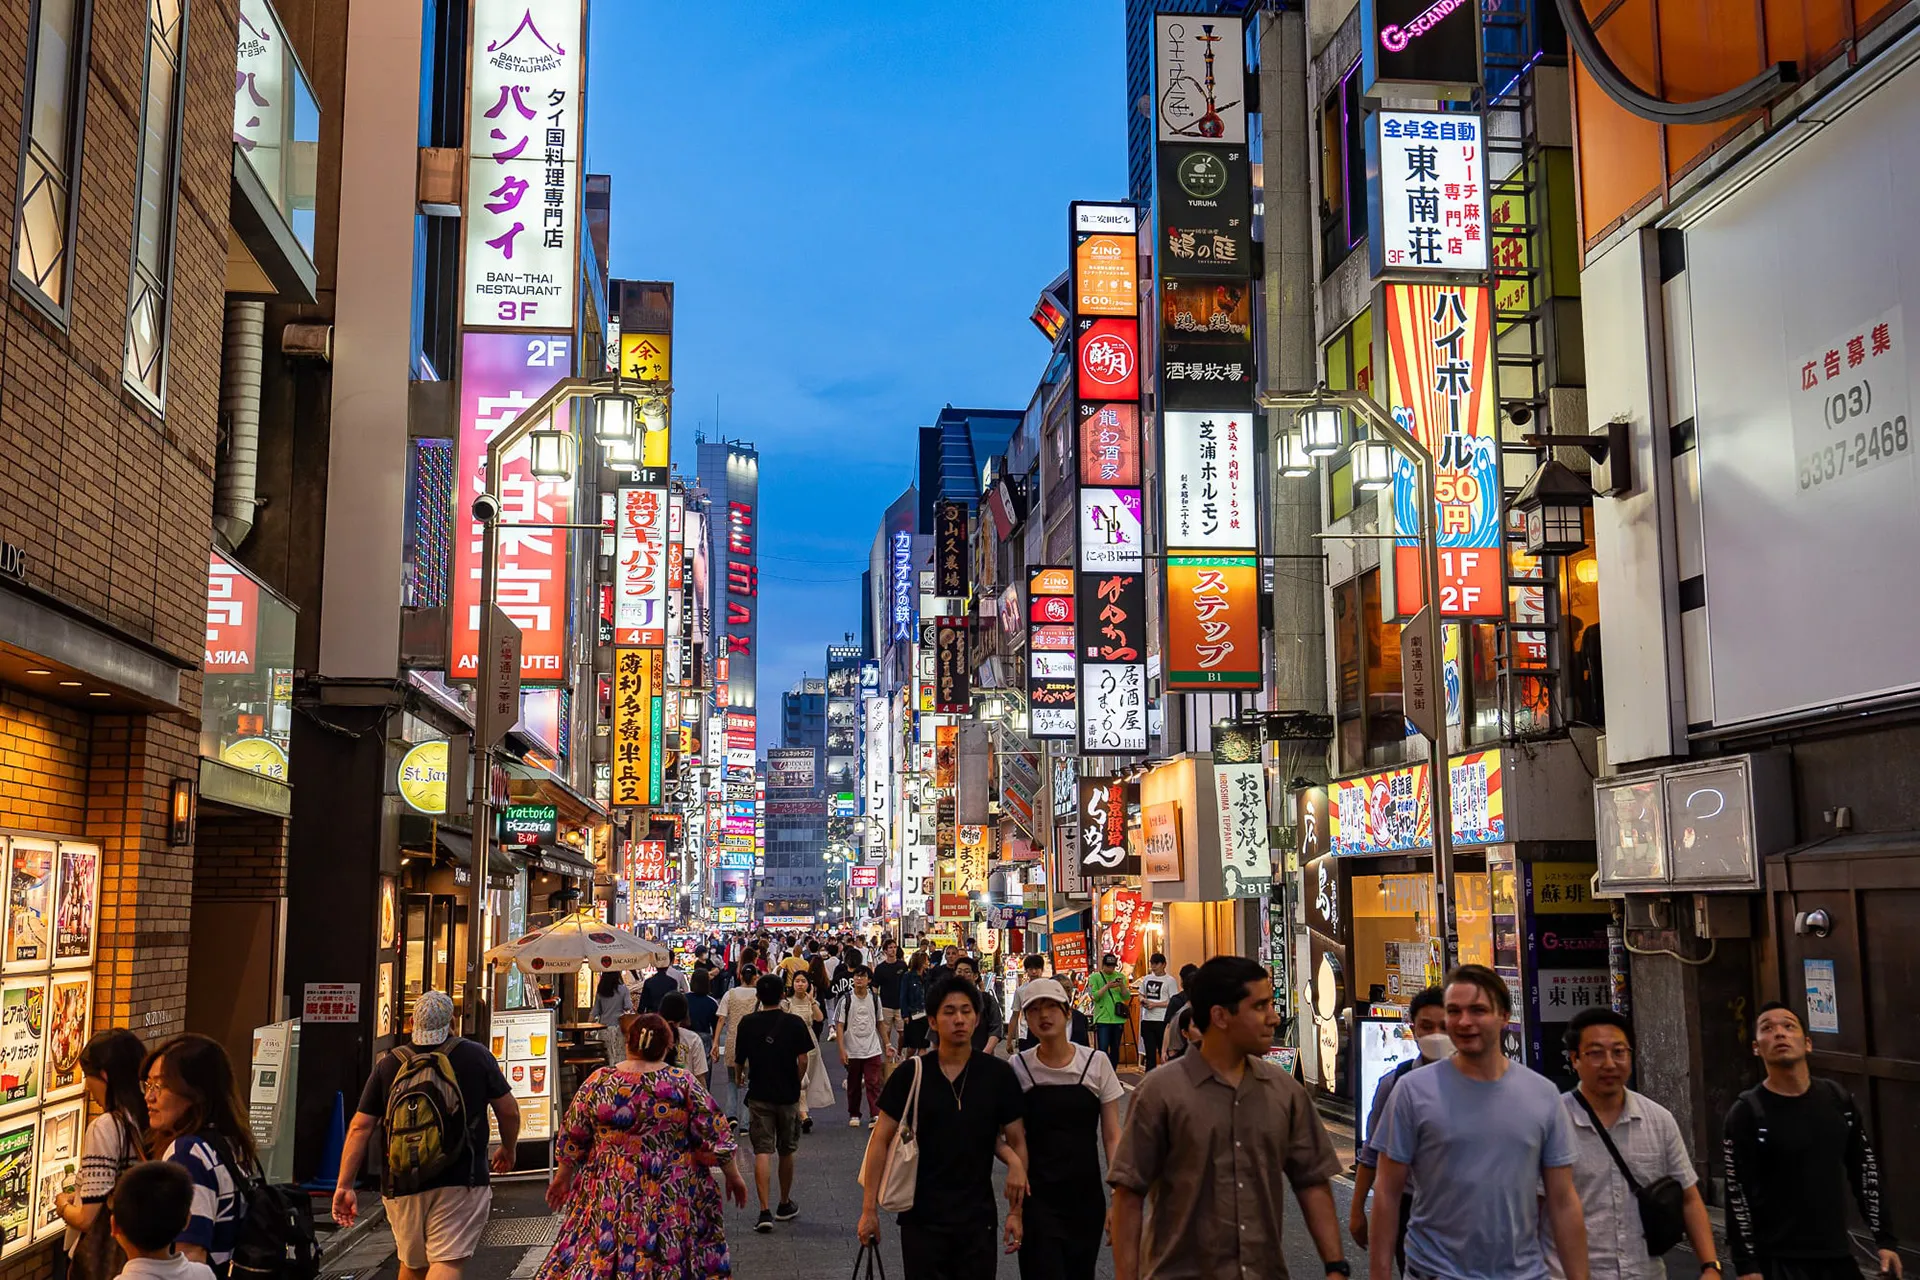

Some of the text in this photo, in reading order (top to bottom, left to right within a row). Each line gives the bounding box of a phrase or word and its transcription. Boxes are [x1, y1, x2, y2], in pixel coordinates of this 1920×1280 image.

[489, 58, 563, 74] RESTAURANT
[498, 52, 553, 65] BAN-THAI
[1384, 119, 1476, 141] 全卓全自動
[1229, 153, 1240, 161] 3F
[483, 85, 537, 260] バンタイ
[543, 88, 566, 249] タイ国料理専門店
[1462, 146, 1481, 242] リーチ麻雀
[1188, 200, 1218, 208] YURUHA
[1404, 145, 1443, 265] 東南荘
[1080, 214, 1132, 224] 第二安田ビル
[1444, 183, 1463, 255] 専門店
[1091, 246, 1122, 255] ZINO
[1388, 250, 1405, 264] 3F
[486, 272, 554, 284] BAN-THAI
[1166, 282, 1179, 291] 2F
[476, 284, 563, 296] RESTAURANT
[498, 301, 539, 321] 3F
[1080, 320, 1092, 330] 4F
[526, 340, 568, 367] 2F
[1090, 341, 1127, 376] 酔月
[1801, 322, 1891, 391] 広告募集
[1166, 362, 1244, 381] 酒場牧場
[1432, 293, 1475, 470] ハイボール
[1081, 405, 1095, 415] 3F
[1824, 379, 1872, 430] (03)
[1098, 409, 1120, 480] 龍幻酒家
[1800, 415, 1909, 490] 5337-2468
[631, 470, 657, 482] B1F
[1199, 420, 1219, 536] 芝浦ホルモン
[1435, 475, 1478, 503] 50
[1123, 496, 1140, 509] 2F
[1443, 504, 1472, 535] 円
[1177, 556, 1247, 565] オンラインカフェ
[1441, 551, 1479, 577] 1F
[895, 531, 912, 640] カラオケの鉄人
[1043, 577, 1069, 586] ZINO
[1440, 587, 1481, 612] 2F
[1192, 569, 1235, 668] ステップ
[628, 630, 652, 644] 4F
[458, 655, 560, 669] ANUTEI
[1208, 672, 1222, 682] B1
[1411, 636, 1425, 710] 劇場通り一番街
[1120, 665, 1142, 731] 居酒屋
[1087, 718, 1097, 748] 一番街
[1124, 738, 1145, 748] B1F
[506, 805, 555, 818] Trattoria
[1219, 774, 1234, 860] HIROSHIMA TEPPANYAKI
[1233, 772, 1267, 867] お好み焼き
[506, 820, 551, 832] Pizzeria
[517, 833, 539, 844] Bar
[1247, 883, 1271, 893] B1F
[1384, 877, 1487, 911] TEPPAN AB
[1541, 884, 1591, 903] 蘇琲
[613, 958, 638, 966] BACARDI
[305, 1002, 357, 1015] 喫煙禁止
[17, 1044, 39, 1060] カラオケ
[1723, 1139, 1736, 1192] STRIPES
[1865, 1148, 1879, 1186] THREE
